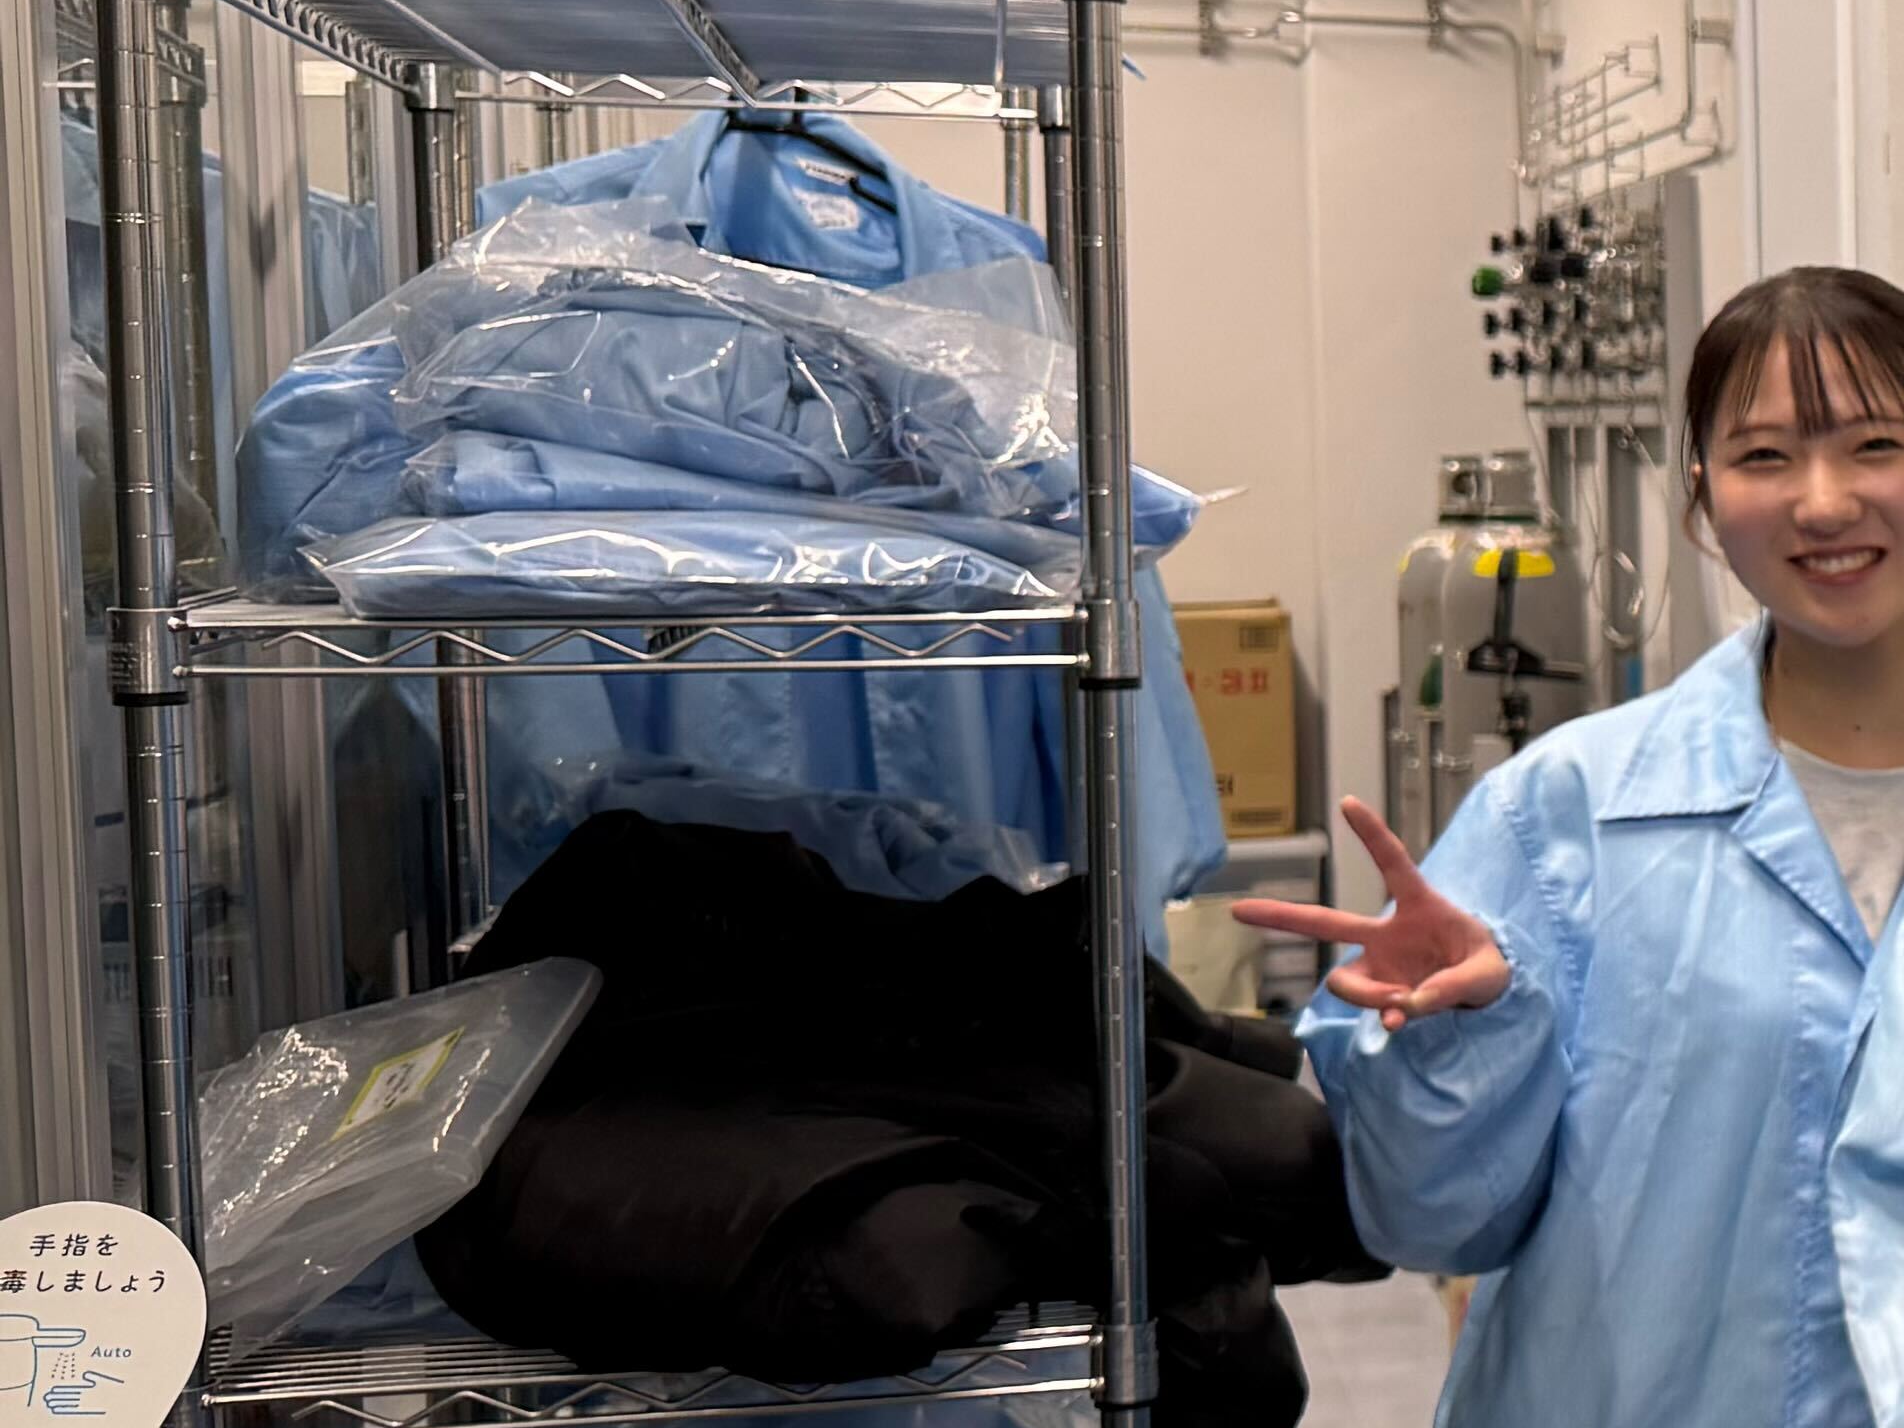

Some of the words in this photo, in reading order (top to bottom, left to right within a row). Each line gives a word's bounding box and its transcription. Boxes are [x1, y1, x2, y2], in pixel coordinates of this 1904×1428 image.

[29, 1233, 119, 1257] 手指を
[91, 1346, 132, 1358] Auto
